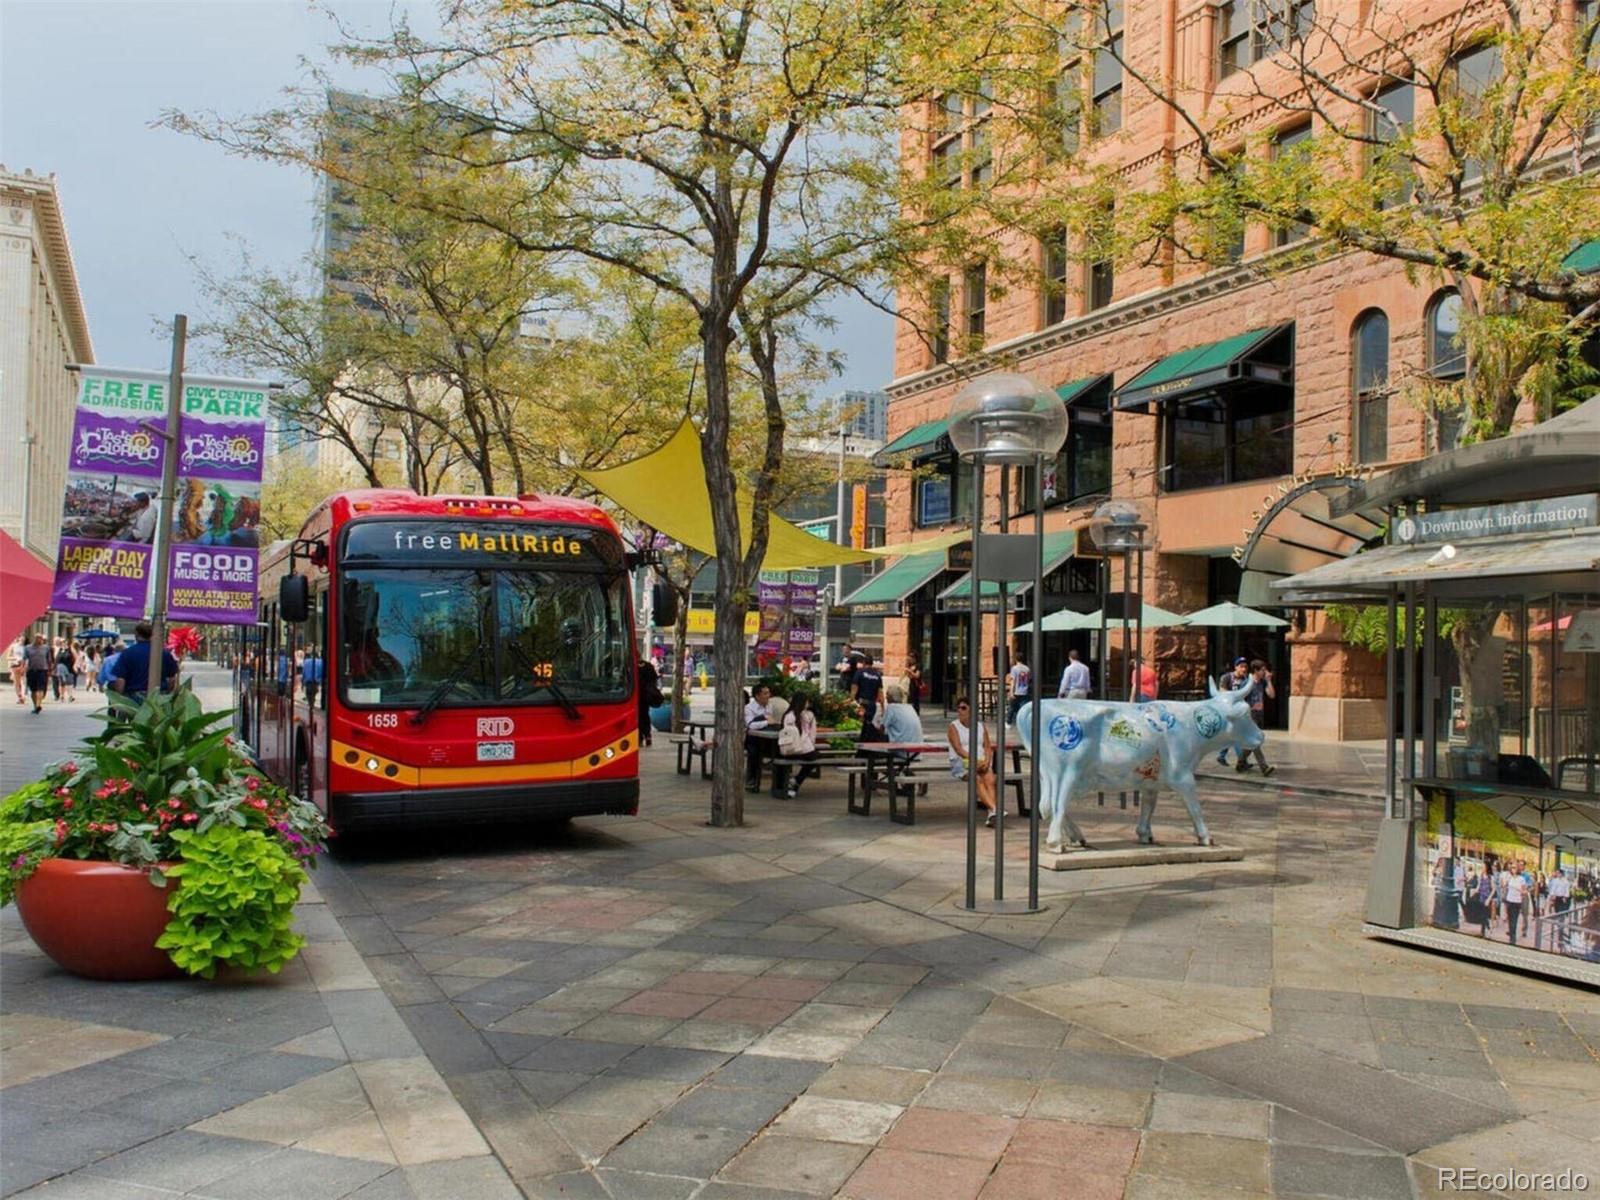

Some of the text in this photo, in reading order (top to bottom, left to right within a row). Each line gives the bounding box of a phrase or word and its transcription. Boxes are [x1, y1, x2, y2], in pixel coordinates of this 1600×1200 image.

[84, 378, 164, 401] FREE
[186, 387, 264, 403] CIVIC CENTER
[82, 394, 164, 412] ADMISSION
[186, 398, 262, 417] PARK
[1231, 468, 1315, 563] MASONIC
[1422, 518, 1494, 535] Downtown
[394, 531, 582, 555] free MallRide
[64, 545, 147, 568] LABOR DAY
[175, 552, 254, 572] FOOD
[62, 561, 144, 579] WEEKEND
[174, 568, 254, 583] MUSIC & MORE
[172, 588, 254, 600] WWW.ATASTEOF
[172, 598, 253, 610] COLORADO.COM
[367, 713, 398, 728] 1658
[477, 717, 515, 737] RTD
